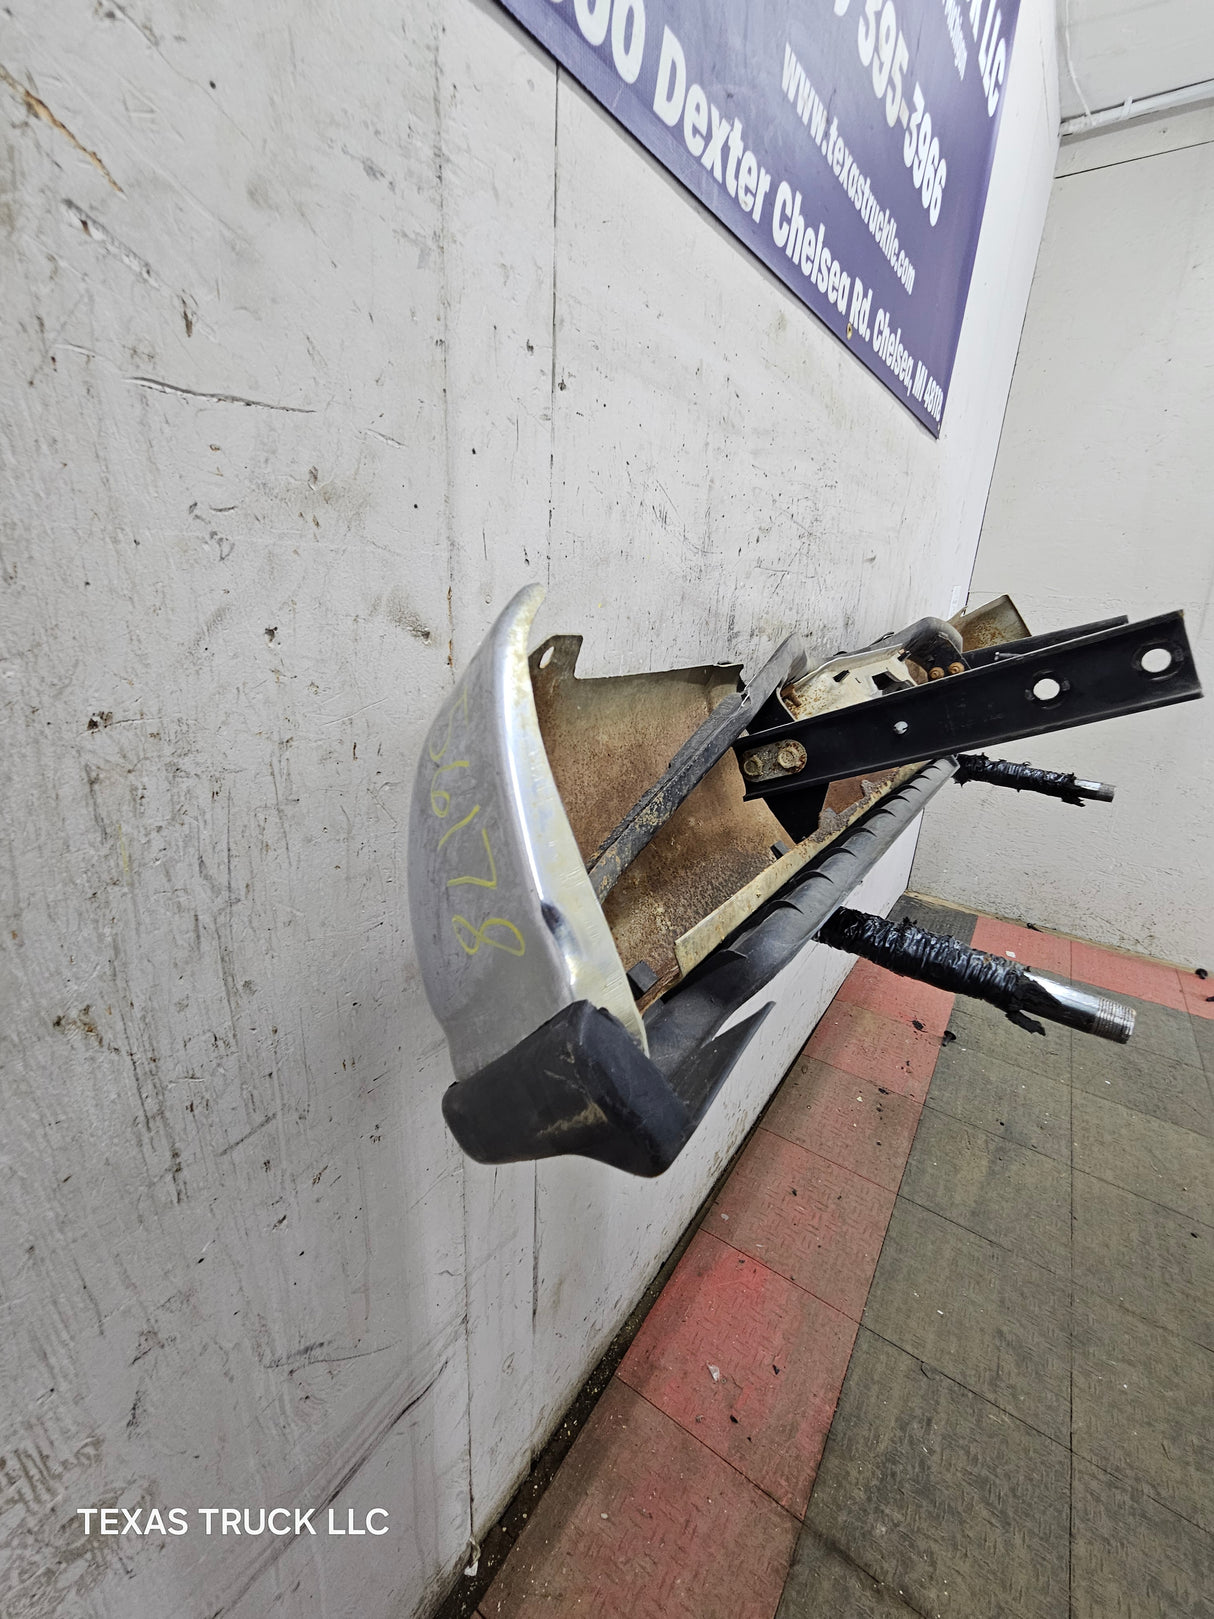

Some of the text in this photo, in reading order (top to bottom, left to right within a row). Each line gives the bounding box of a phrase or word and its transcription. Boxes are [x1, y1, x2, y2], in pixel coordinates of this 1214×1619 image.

[653, 24, 771, 223] Dexter
[772, 180, 850, 315] Chelsea
[850, 276, 873, 342] Rd.
[873, 308, 914, 396] Chelsea,
[912, 360, 928, 402] MI
[782, 41, 915, 295] www.texastruckllc.com
